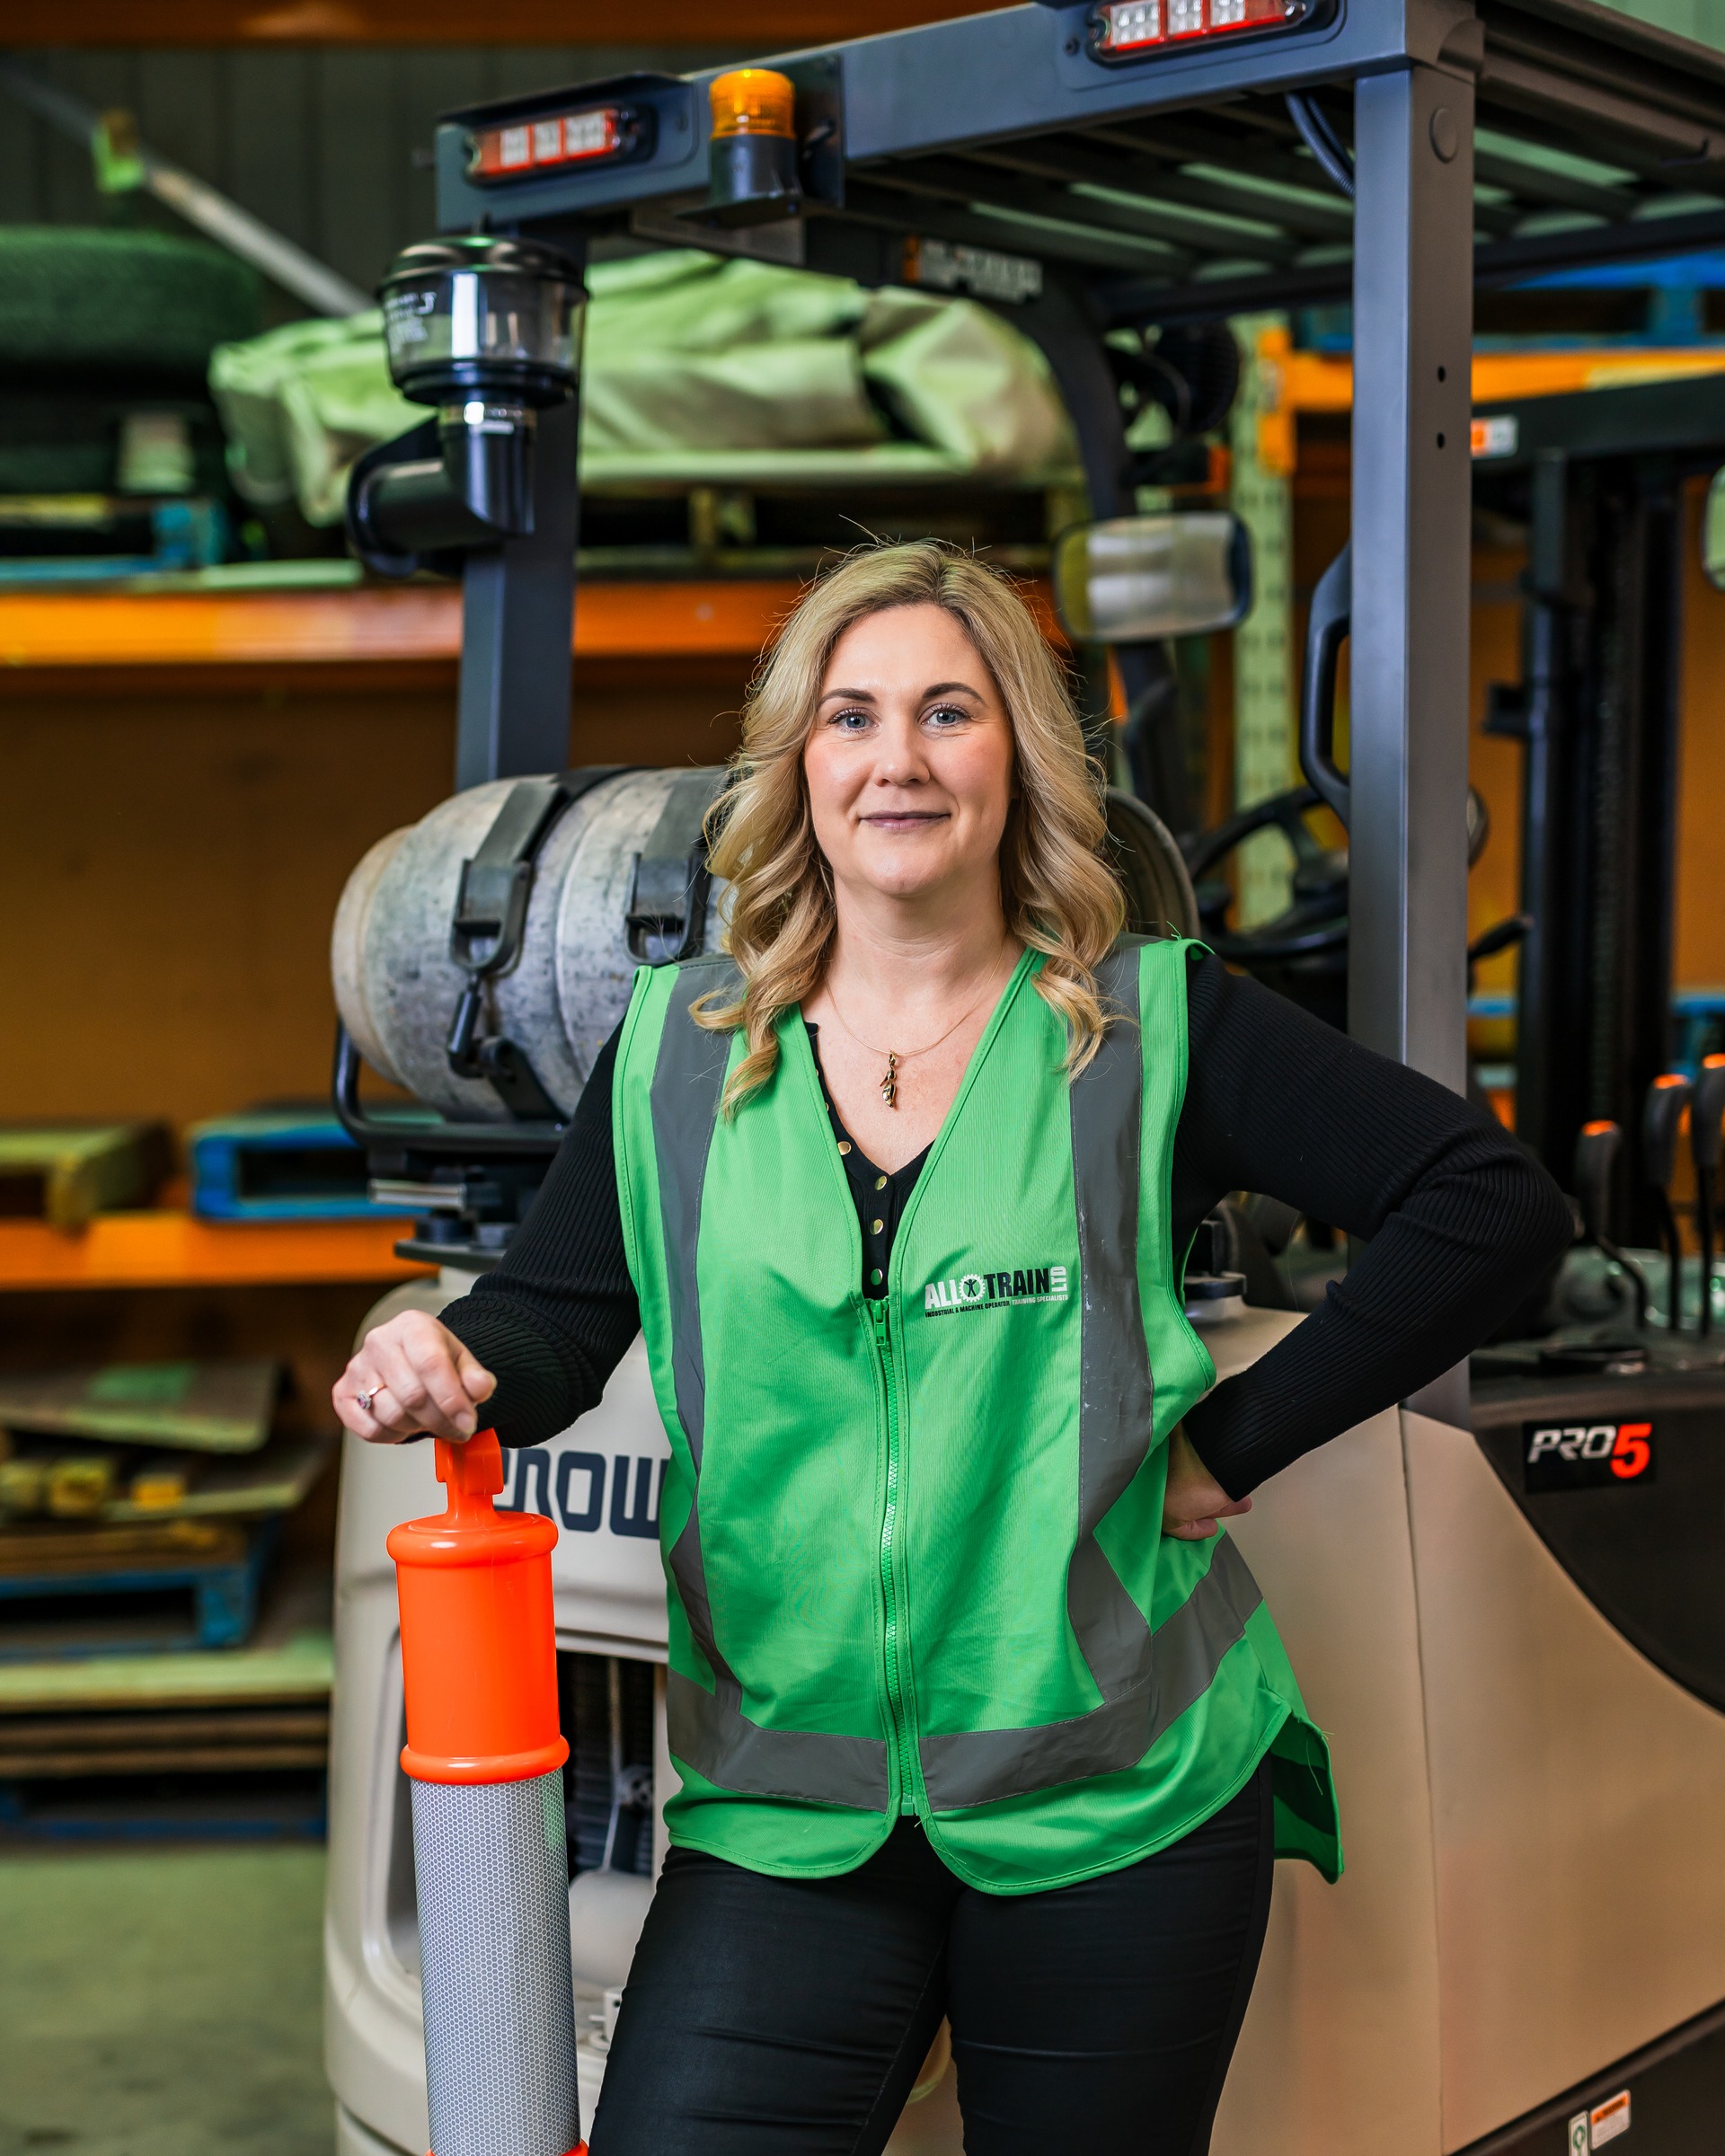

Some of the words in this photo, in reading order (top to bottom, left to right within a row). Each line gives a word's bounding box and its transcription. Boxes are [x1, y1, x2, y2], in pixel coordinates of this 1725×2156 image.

[924, 1308, 954, 1318] INDUSTRIAL
[960, 1303, 984, 1312] MACHINE
[985, 1300, 1010, 1309] OPERATOR
[1012, 1296, 1036, 1305] TRAINING
[1037, 1294, 1068, 1303] SPECIALISTS
[925, 1279, 962, 1310] ALL
[984, 1268, 1049, 1299] TRAIN
[1050, 1266, 1067, 1292] LTD
[494, 1448, 670, 1540] ROW
